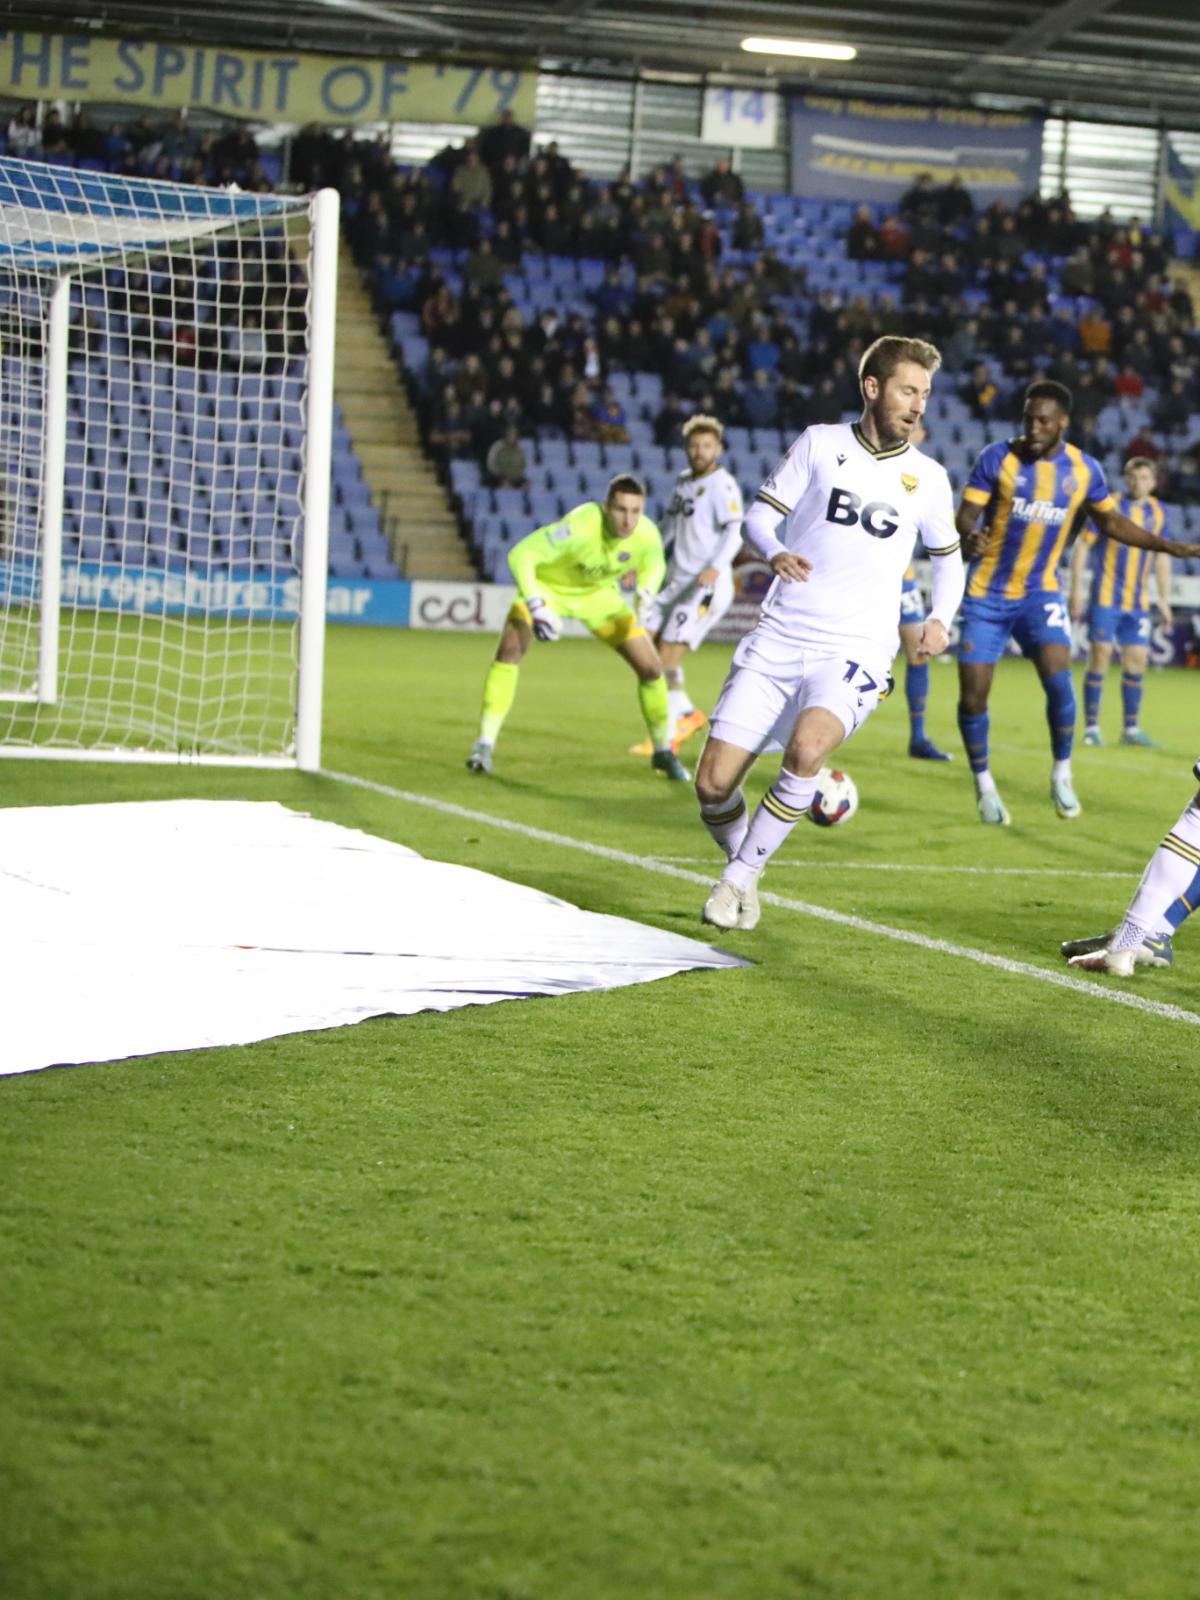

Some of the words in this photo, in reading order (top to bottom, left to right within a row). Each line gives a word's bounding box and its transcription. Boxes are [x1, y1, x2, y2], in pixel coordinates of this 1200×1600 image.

[113, 37, 299, 113] SPIRIT
[320, 63, 409, 116] OF
[715, 86, 765, 126] 14
[825, 486, 900, 540] BG
[675, 611, 688, 630] 9
[842, 659, 878, 693] 17
